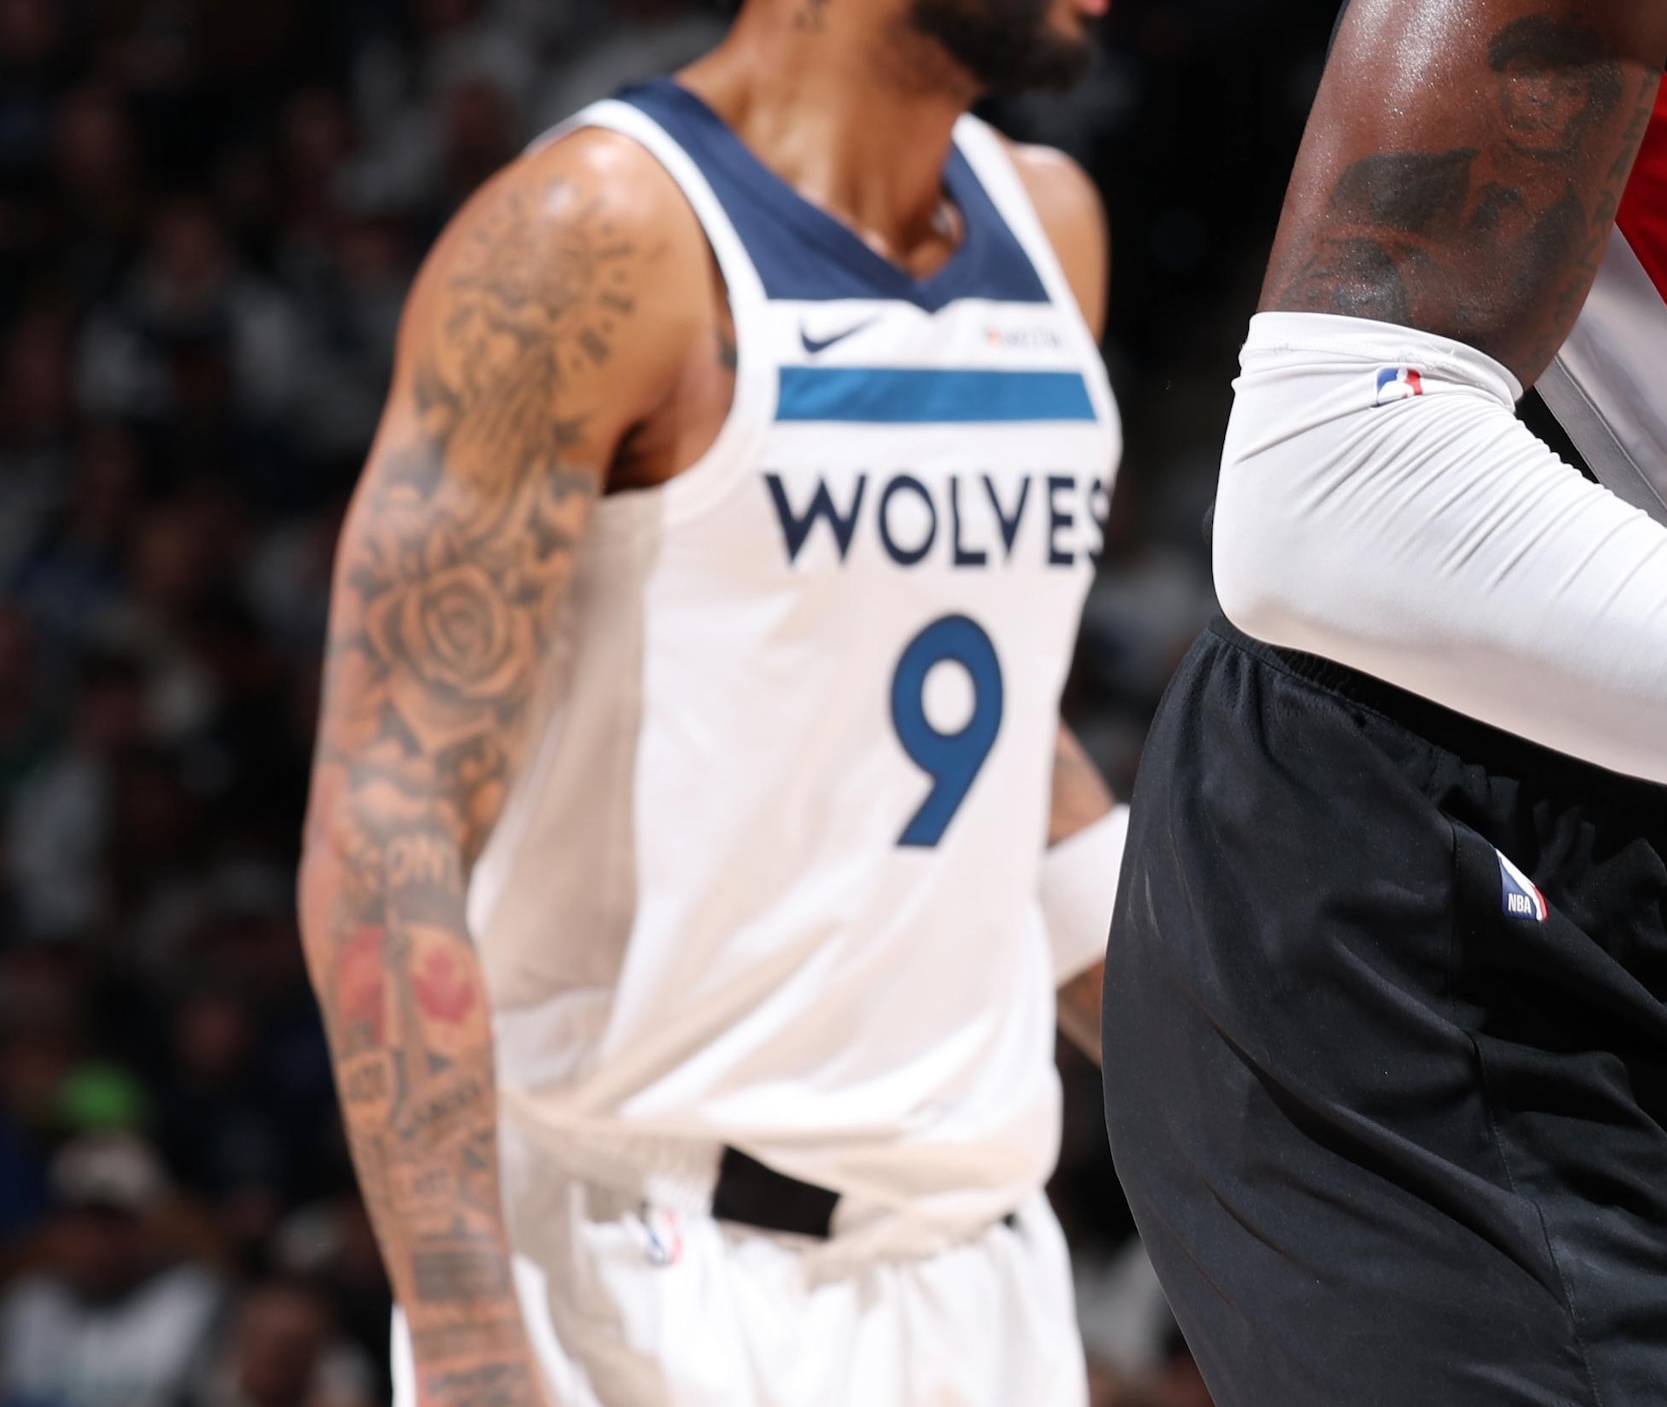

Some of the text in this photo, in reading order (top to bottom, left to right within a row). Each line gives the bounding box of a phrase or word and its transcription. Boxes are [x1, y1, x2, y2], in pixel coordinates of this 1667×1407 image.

[763, 474, 1108, 567] WOLVES
[890, 614, 1002, 848] 9
[1508, 893, 1532, 915] NBA
